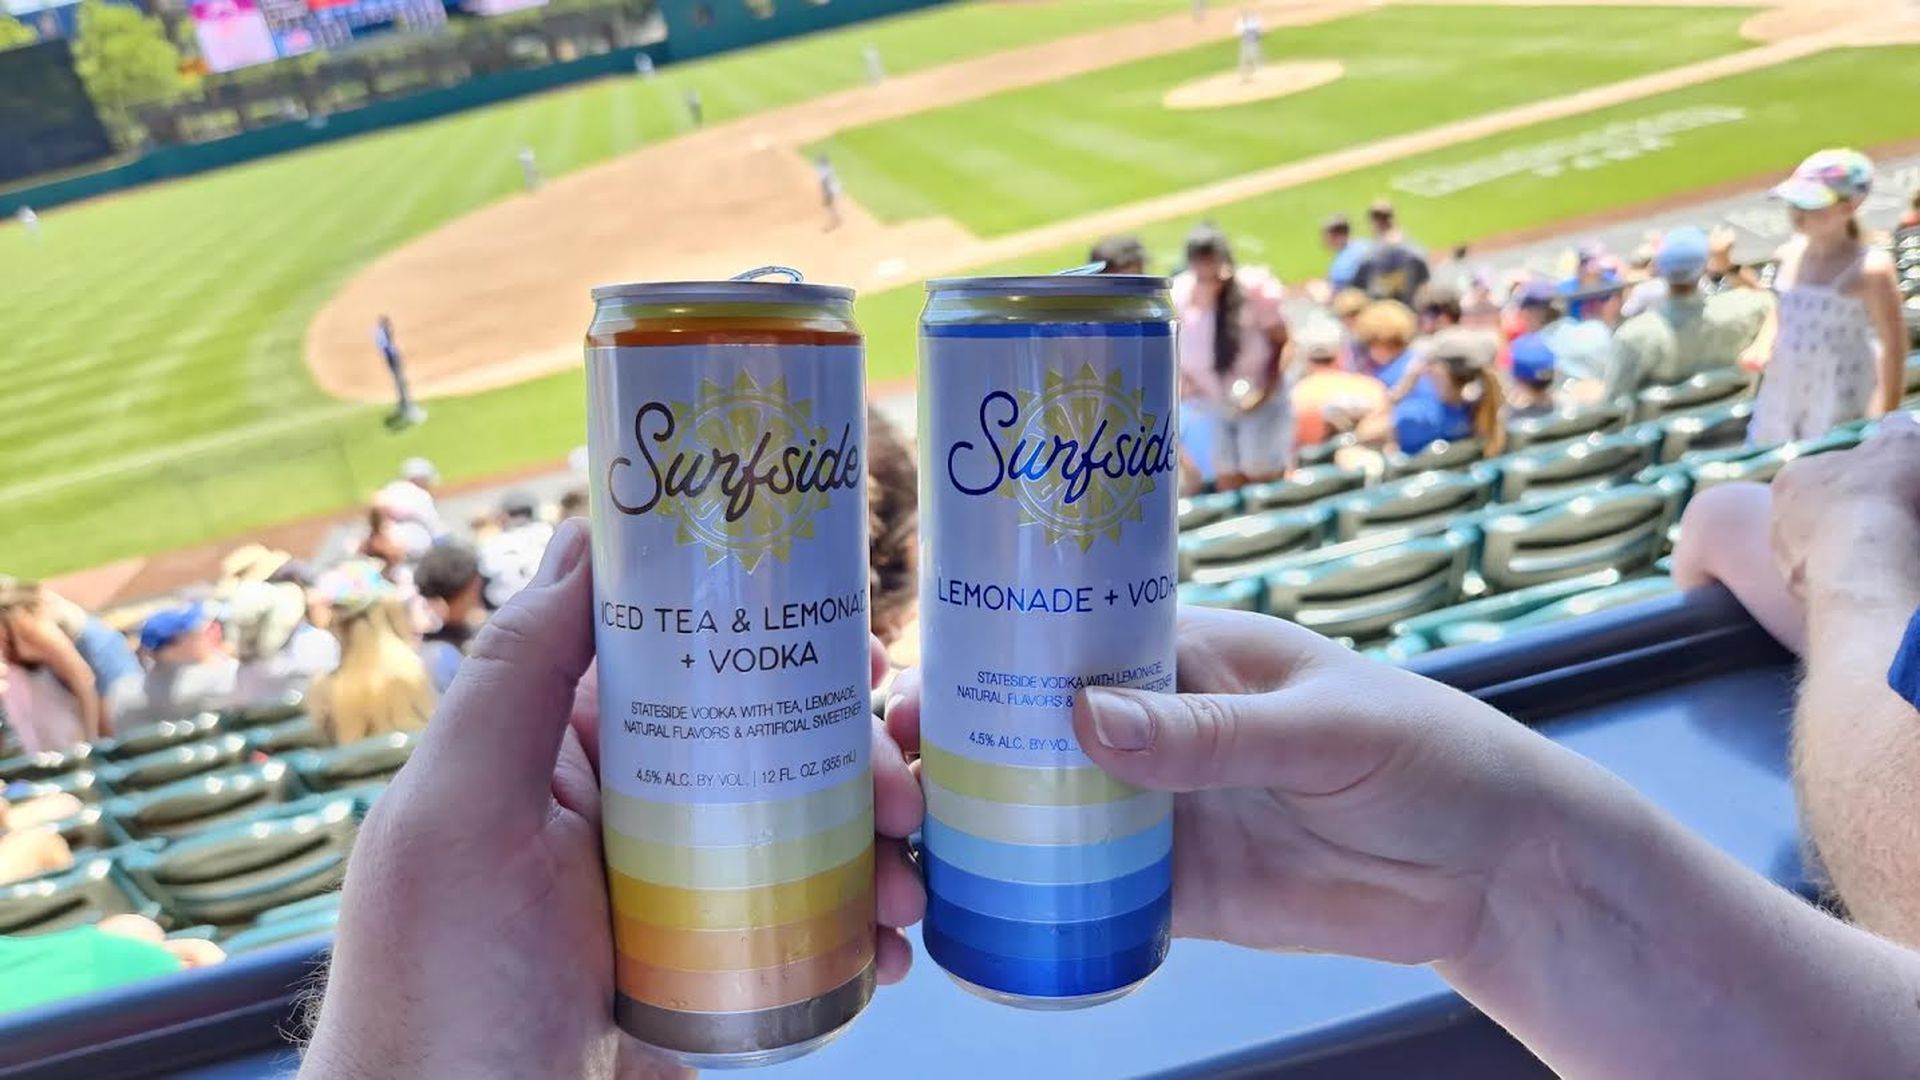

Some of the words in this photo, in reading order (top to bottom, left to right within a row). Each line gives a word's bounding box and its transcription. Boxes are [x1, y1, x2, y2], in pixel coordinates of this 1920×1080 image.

[608, 402, 861, 522] Surfside
[937, 576, 1093, 613] LEMONADE
[1104, 589, 1118, 605] +
[601, 601, 643, 630] ICED
[654, 608, 718, 633] TEA
[732, 608, 751, 634] &
[680, 653, 696, 669] +
[708, 641, 819, 674] VODKA
[977, 671, 1037, 687] STATESIDE
[1042, 675, 1085, 690] VODKA
[1086, 673, 1115, 687] WITH
[631, 700, 688, 720] STATESIDE
[690, 704, 737, 720] VODKA
[740, 703, 774, 719] WITH
[776, 699, 802, 714] TEA,
[957, 685, 1004, 705] NATURAL
[1007, 693, 1063, 708] FLAVORS
[1066, 695, 1074, 708] &
[624, 719, 670, 739] NATURAL
[673, 726, 730, 740] FLAVORS
[734, 727, 742, 739] &
[746, 719, 811, 738] ARTIFICIAL
[969, 731, 995, 748] 4.5%
[999, 734, 1026, 750] ALC.
[1029, 738, 1046, 750] BY
[636, 767, 662, 784] 4.5%
[665, 772, 693, 787] ALC.
[697, 774, 715, 787] BY
[762, 771, 775, 784] 12
[821, 755, 842, 776] (355
